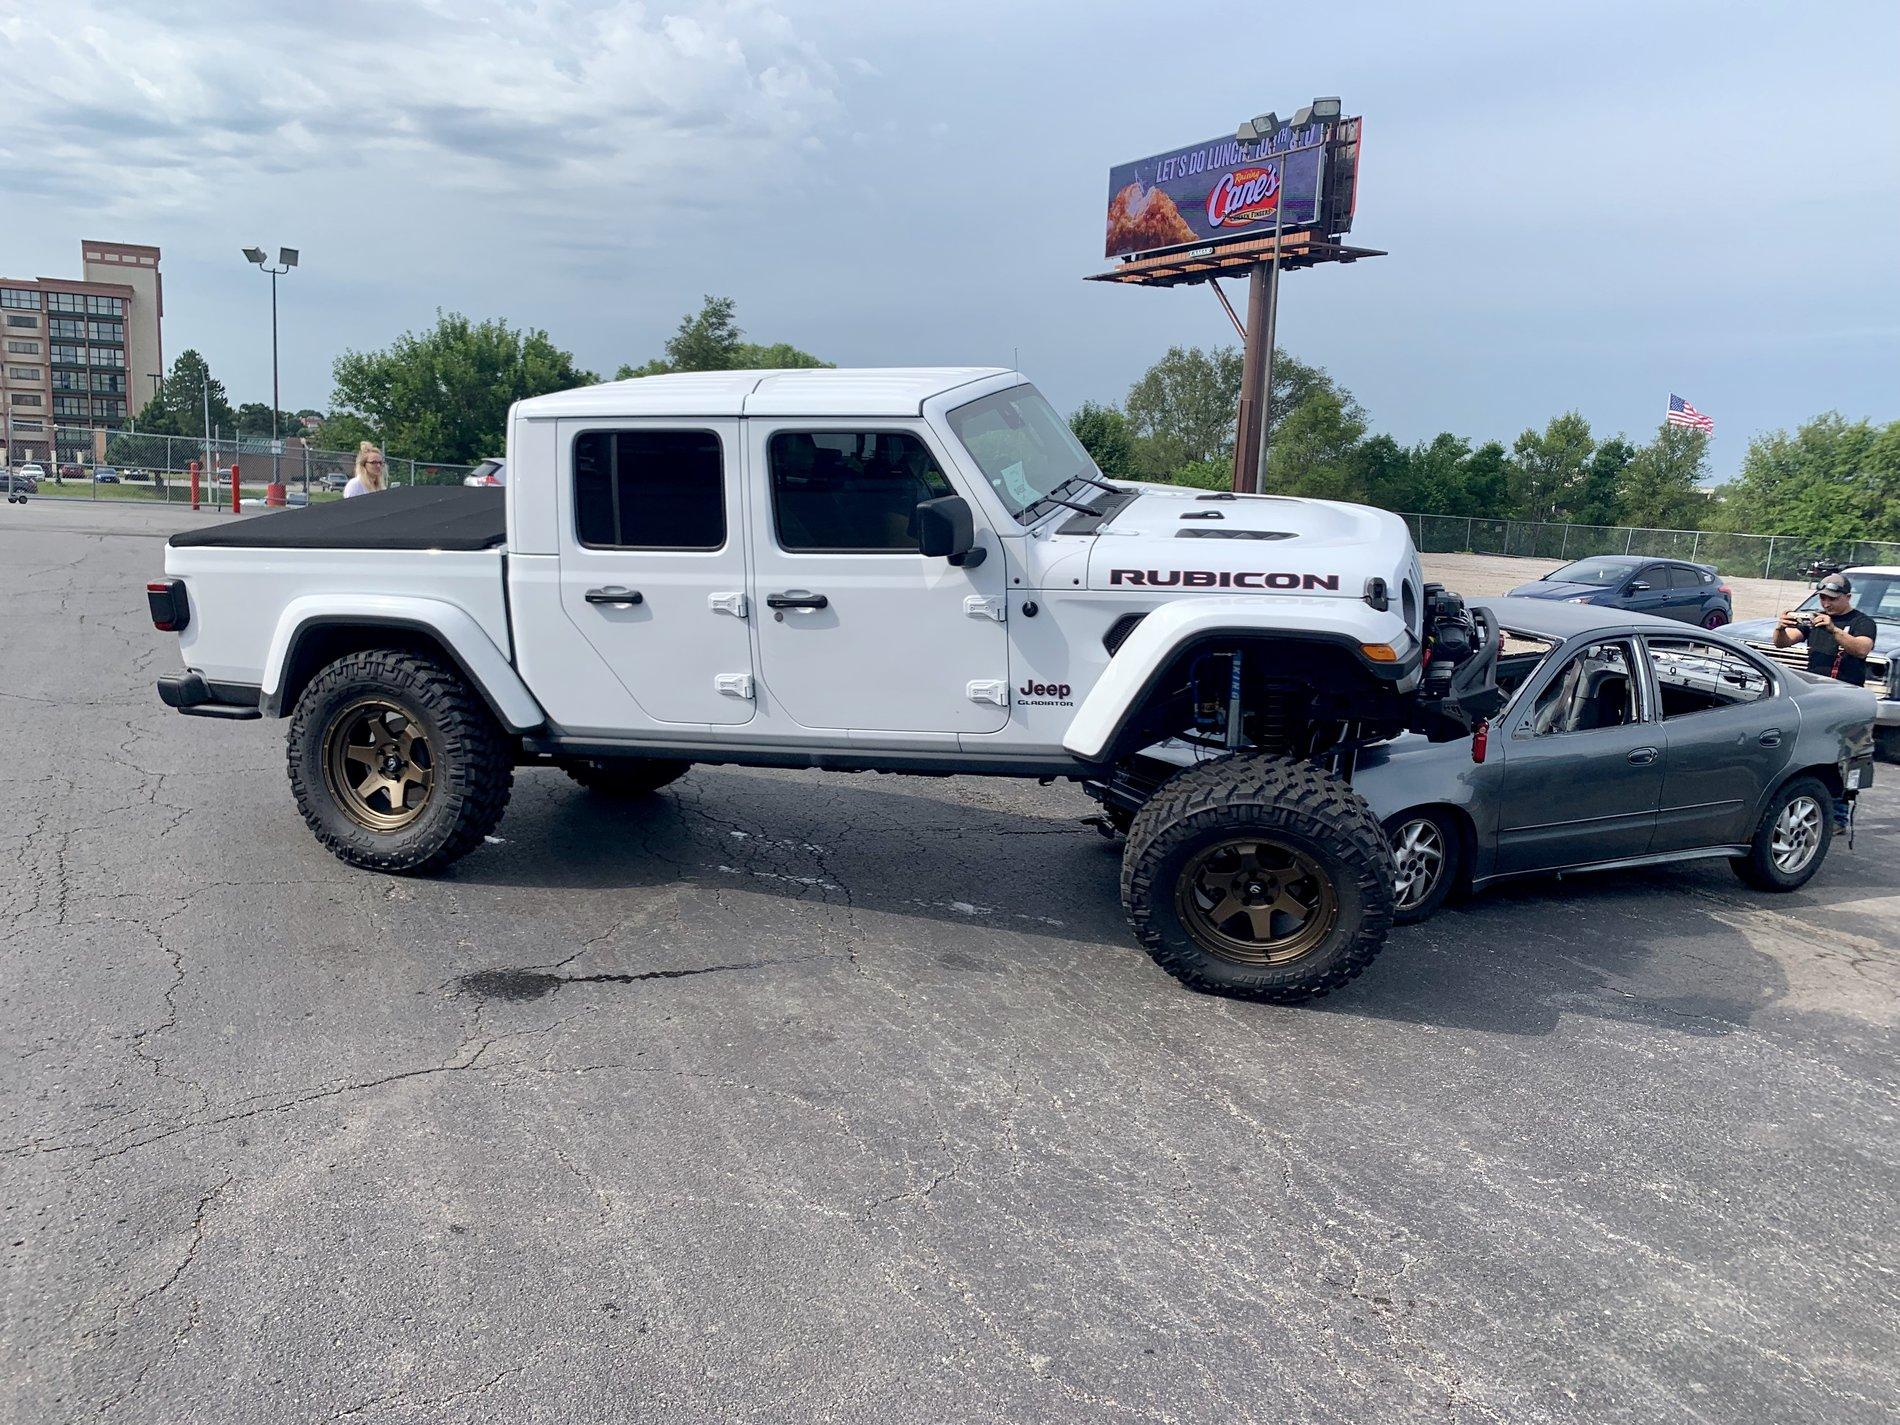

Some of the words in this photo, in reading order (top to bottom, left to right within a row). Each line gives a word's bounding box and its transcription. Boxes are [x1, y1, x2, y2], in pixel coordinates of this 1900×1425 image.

[1156, 155, 1187, 183] LET'S
[1188, 150, 1205, 175] DO
[1208, 163, 1280, 227] Cane's
[1110, 569, 1340, 591] RUBICON
[1020, 679, 1071, 700] Jeep
[1017, 699, 1074, 707] GLADIATOR
